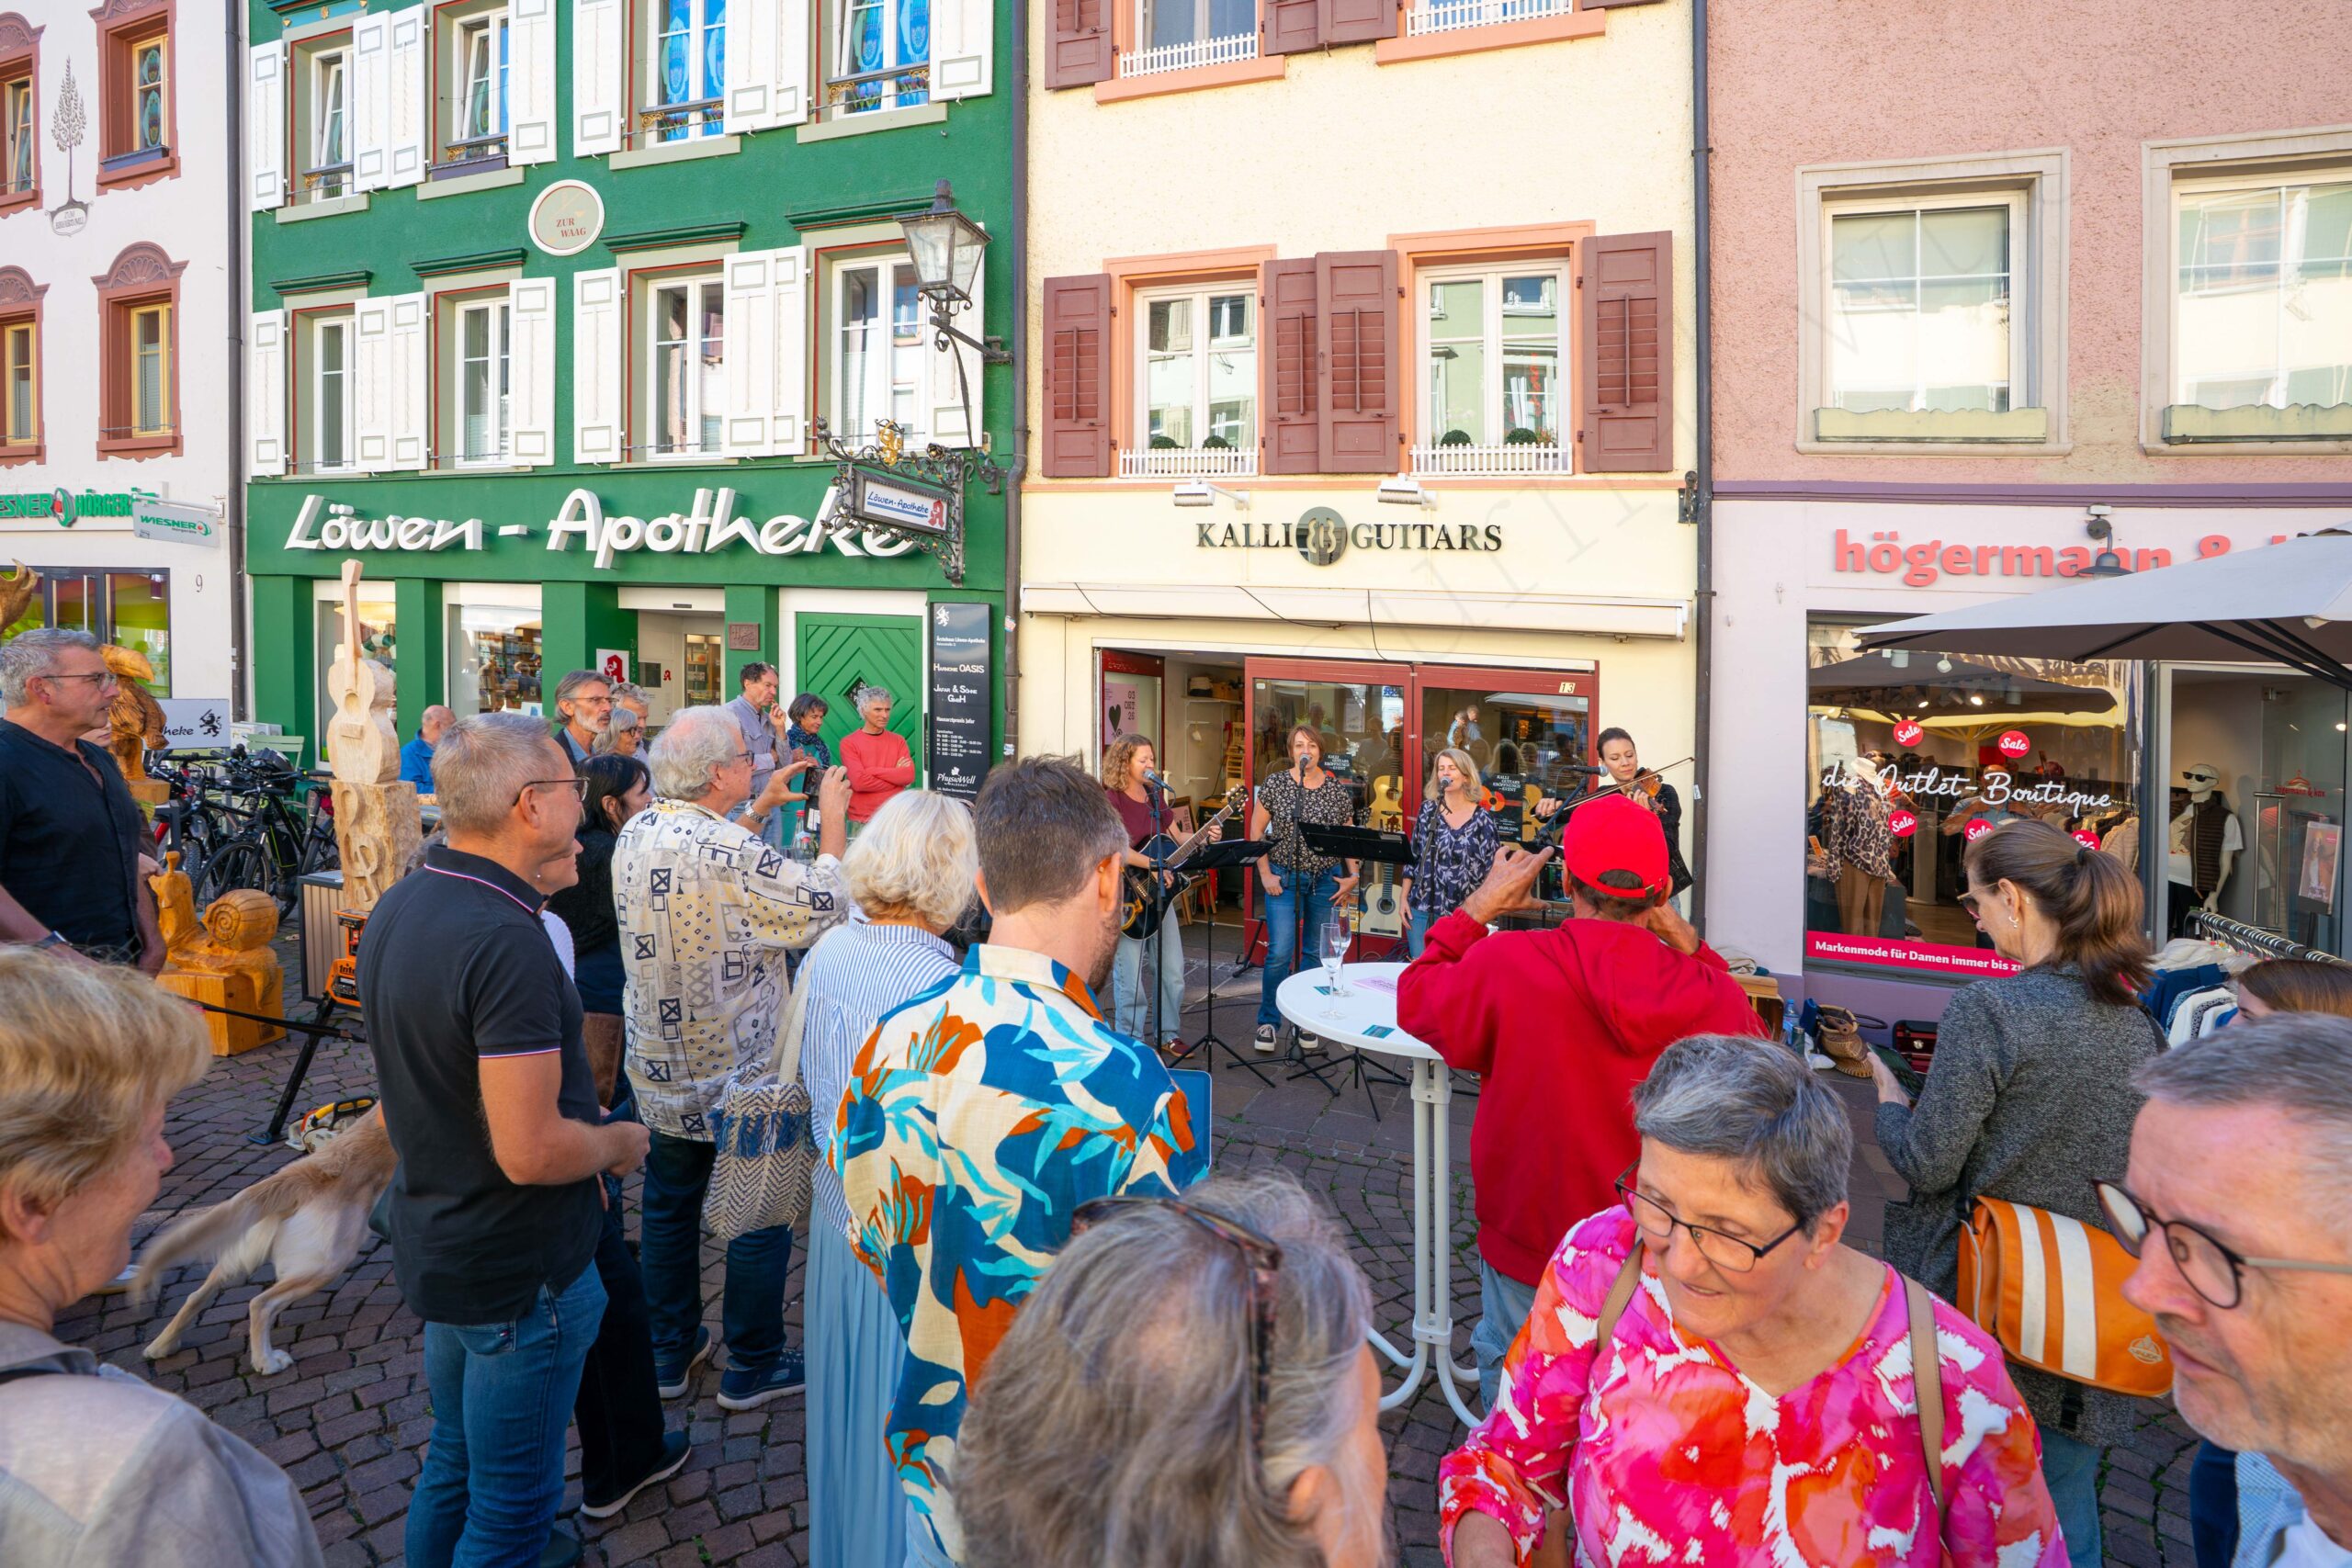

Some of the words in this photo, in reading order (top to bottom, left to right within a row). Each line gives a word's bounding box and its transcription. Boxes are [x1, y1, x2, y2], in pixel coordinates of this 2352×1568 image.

[556, 218, 575, 228] ZUR
[561, 227, 587, 238] WAAG
[141, 515, 197, 530] WIESNER
[283, 494, 484, 551] Löwen
[547, 486, 915, 570] Apotheke
[1195, 523, 1294, 548] KALLI
[1351, 523, 1502, 551] GUITARS
[1835, 529, 2172, 587] högermann
[196, 574, 203, 593] 9
[959, 664, 984, 673] OASIS
[953, 684, 958, 694] &
[1562, 682, 1574, 693] 13
[1898, 726, 1920, 743] Sale
[2001, 738, 2028, 751] Sale
[937, 773, 976, 784] PhysioWell
[1892, 817, 1915, 834] Sale
[1968, 826, 1992, 841] Sale
[1815, 941, 1888, 957] Markenmode
[1890, 949, 1906, 960] für
[1909, 950, 1950, 964] Damen
[1951, 954, 1990, 968] immer
[1991, 959, 2008, 971] bis
